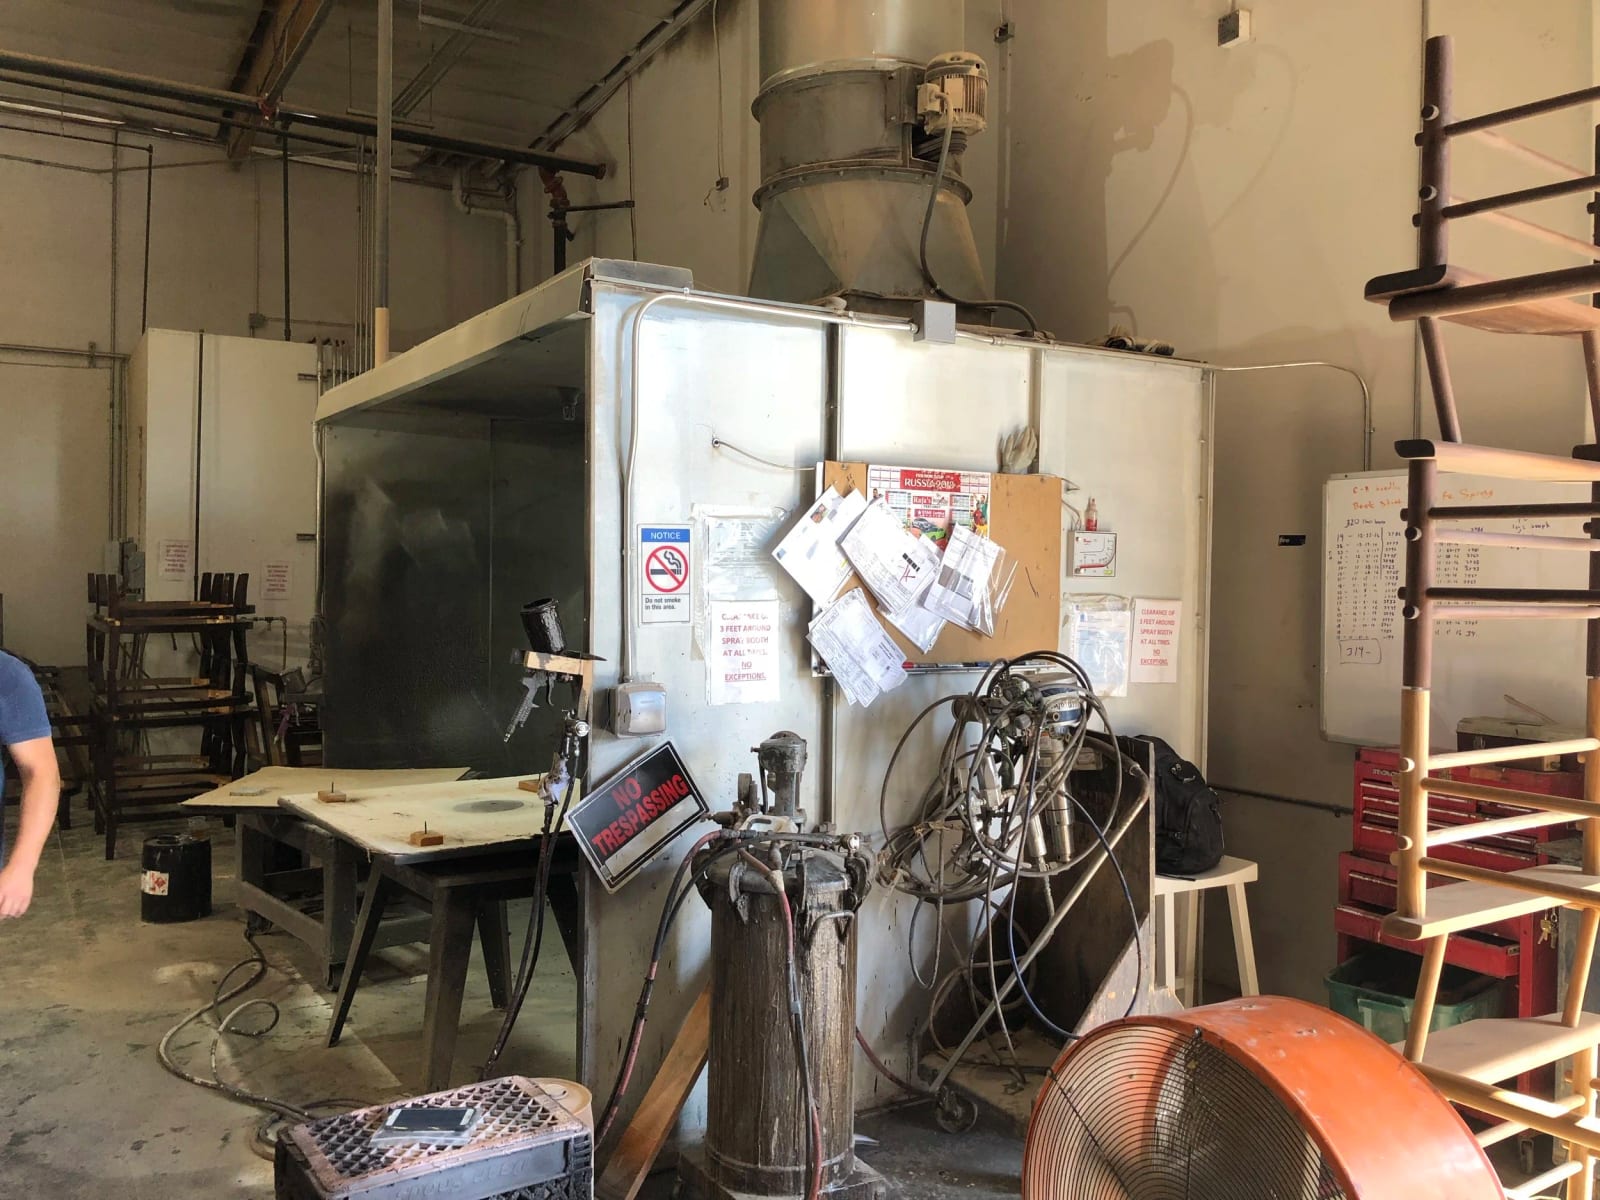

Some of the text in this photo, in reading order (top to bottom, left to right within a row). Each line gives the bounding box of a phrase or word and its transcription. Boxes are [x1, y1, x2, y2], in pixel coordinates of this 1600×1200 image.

[904, 477, 935, 488] RUSSIA
[650, 531, 681, 540] NOTICE
[741, 661, 752, 669] NO
[611, 777, 642, 810] NO
[592, 774, 689, 856] TRESPASSING
